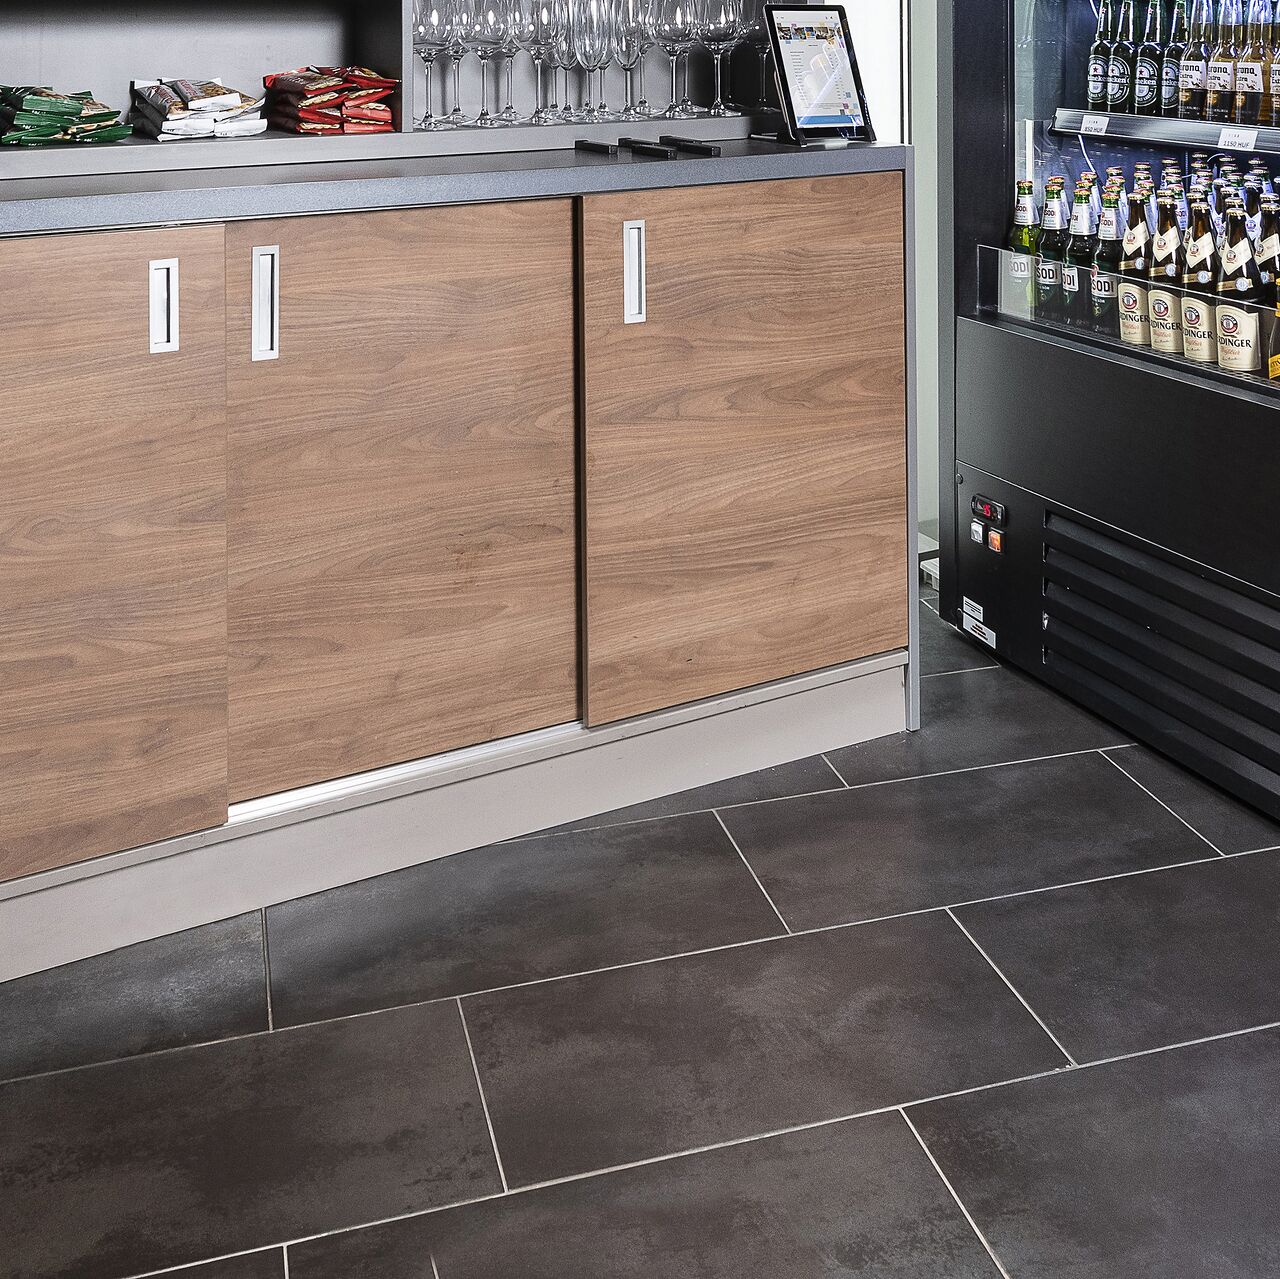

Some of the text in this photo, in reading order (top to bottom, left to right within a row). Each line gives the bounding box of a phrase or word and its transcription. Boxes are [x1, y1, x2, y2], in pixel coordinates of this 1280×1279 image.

[1236, 141, 1250, 149] HUF
[1009, 261, 1029, 273] SODI
[1037, 264, 1059, 280] SODI
[1092, 277, 1114, 294] SODI
